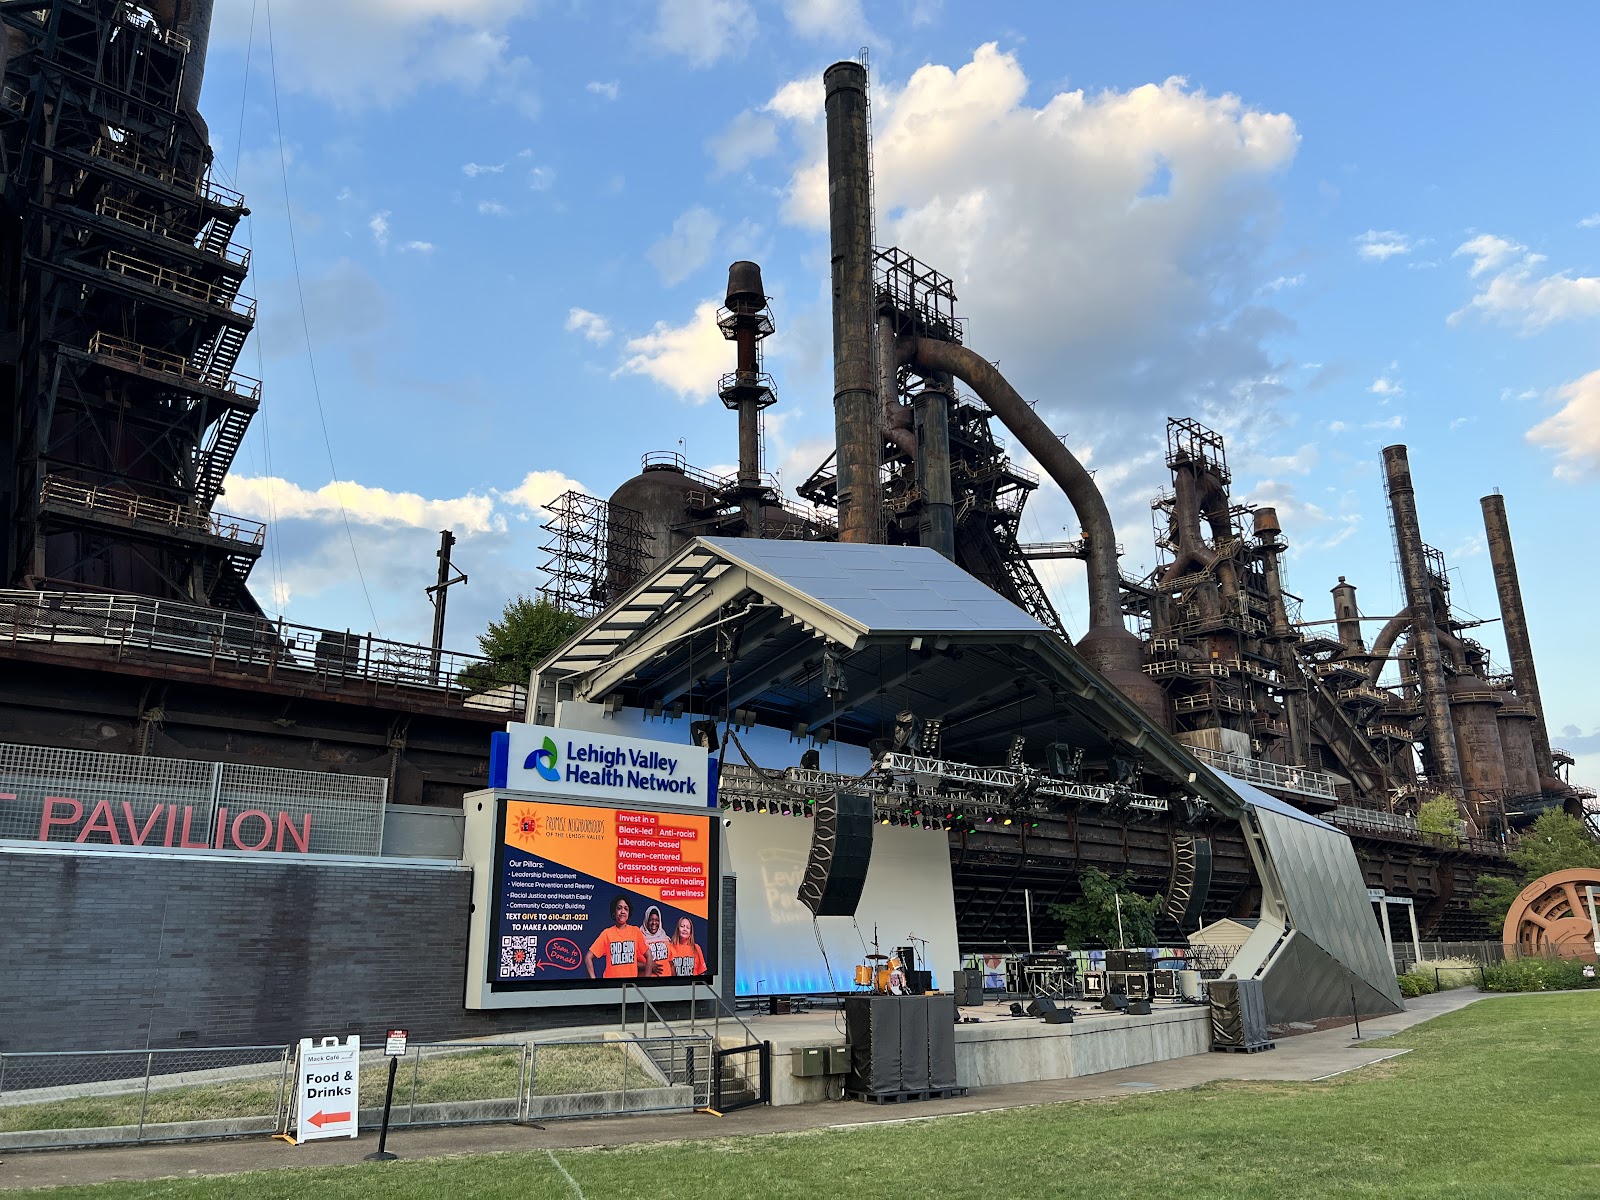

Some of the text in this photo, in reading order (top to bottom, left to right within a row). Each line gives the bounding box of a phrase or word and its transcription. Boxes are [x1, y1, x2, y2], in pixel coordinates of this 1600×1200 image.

[567, 741, 677, 775] Lehigh Valley
[565, 763, 696, 794] Health Network
[39, 796, 312, 853] PAVILION
[545, 815, 605, 834] PROMISE NEIGHBORHOODS
[619, 814, 641, 823] Invest
[642, 815, 649, 823] in
[618, 826, 696, 838] Black-led Anti-racist
[618, 838, 680, 849] Liberation-based
[618, 850, 680, 861] Women-centered
[509, 860, 522, 868] Our
[617, 862, 701, 874] Grassroots organization
[542, 872, 577, 880] Development
[617, 876, 633, 884] that
[634, 876, 640, 884] is
[641, 876, 669, 885] focused
[680, 877, 705, 886] healing
[552, 942, 570, 954] Scan
[610, 941, 635, 954] END GUN
[550, 951, 576, 964] Donate
[611, 953, 635, 965] VIOLENCE
[683, 957, 694, 967] GUN
[306, 1070, 353, 1084] Food &
[307, 1086, 352, 1099] Drinks
